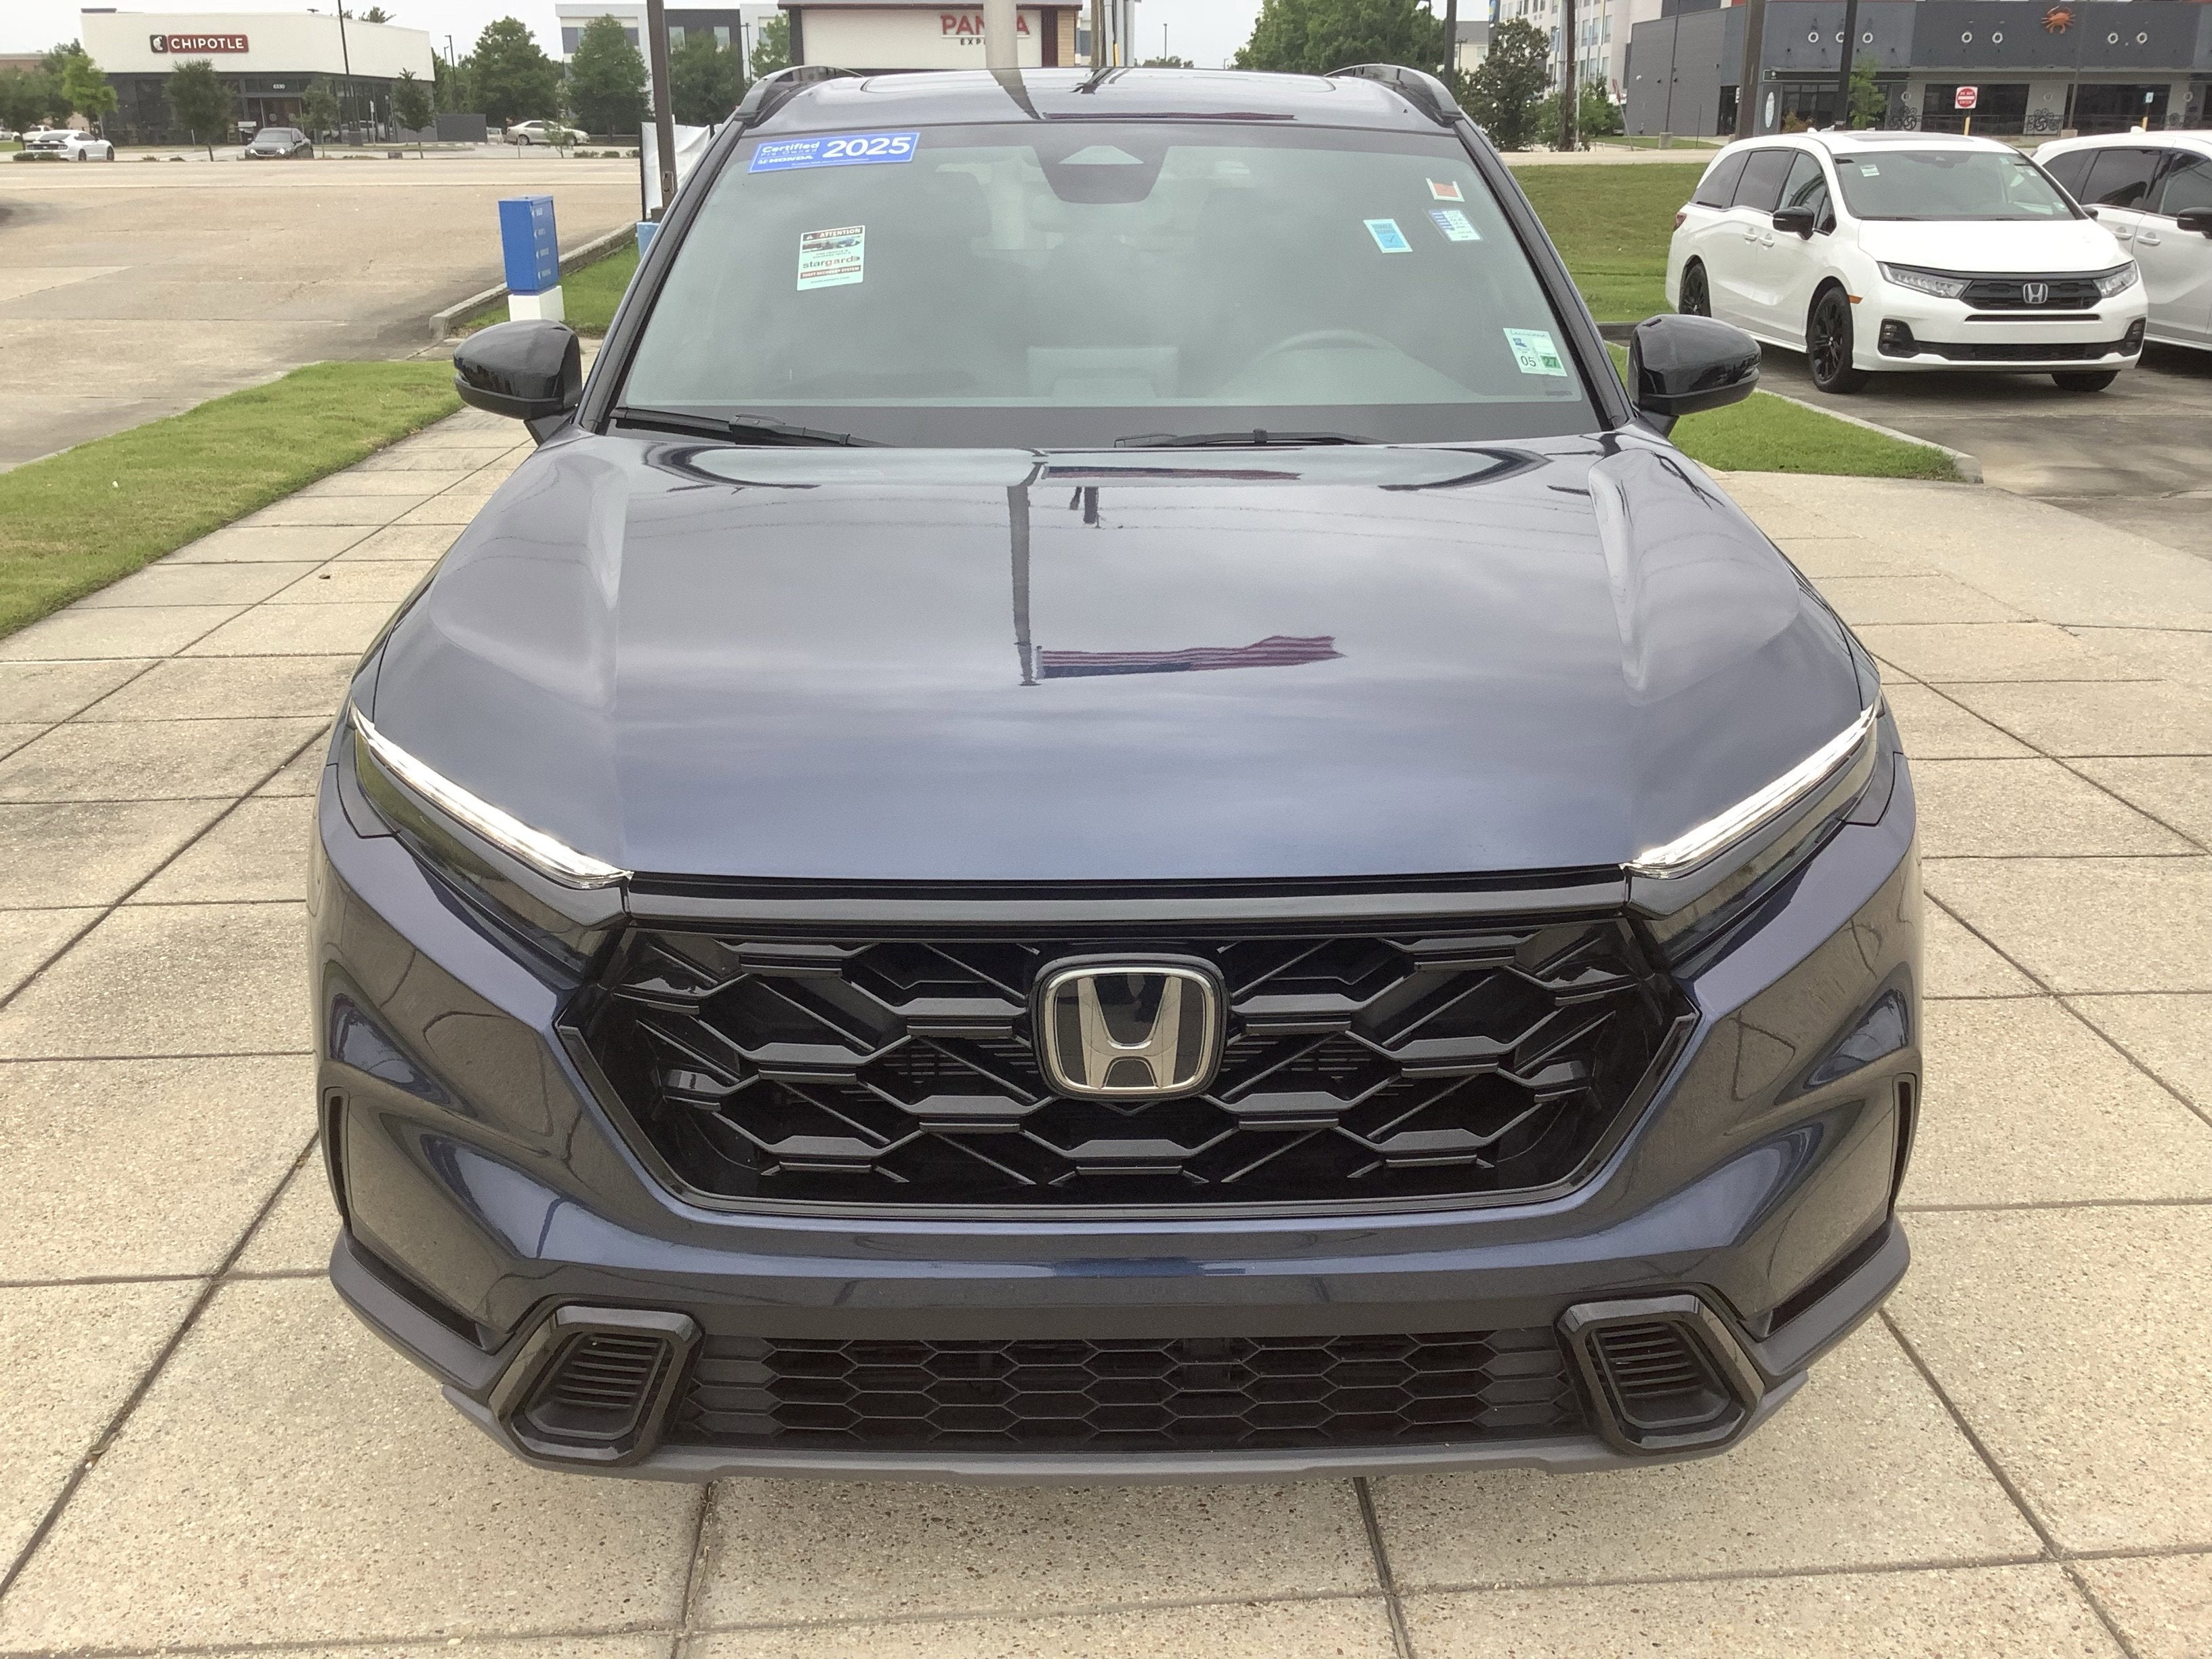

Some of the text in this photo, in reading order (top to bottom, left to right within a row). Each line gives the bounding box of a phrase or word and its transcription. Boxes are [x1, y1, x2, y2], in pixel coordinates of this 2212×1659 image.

[941, 15, 1030, 35] PANA
[171, 38, 244, 49] CHIPOTLE
[762, 141, 820, 153] Certified
[822, 137, 912, 158] 2025
[769, 155, 813, 163] HONDA
[819, 228, 861, 238] ATTENTION
[802, 255, 854, 268] stargard
[1521, 355, 1557, 367] 05 27
